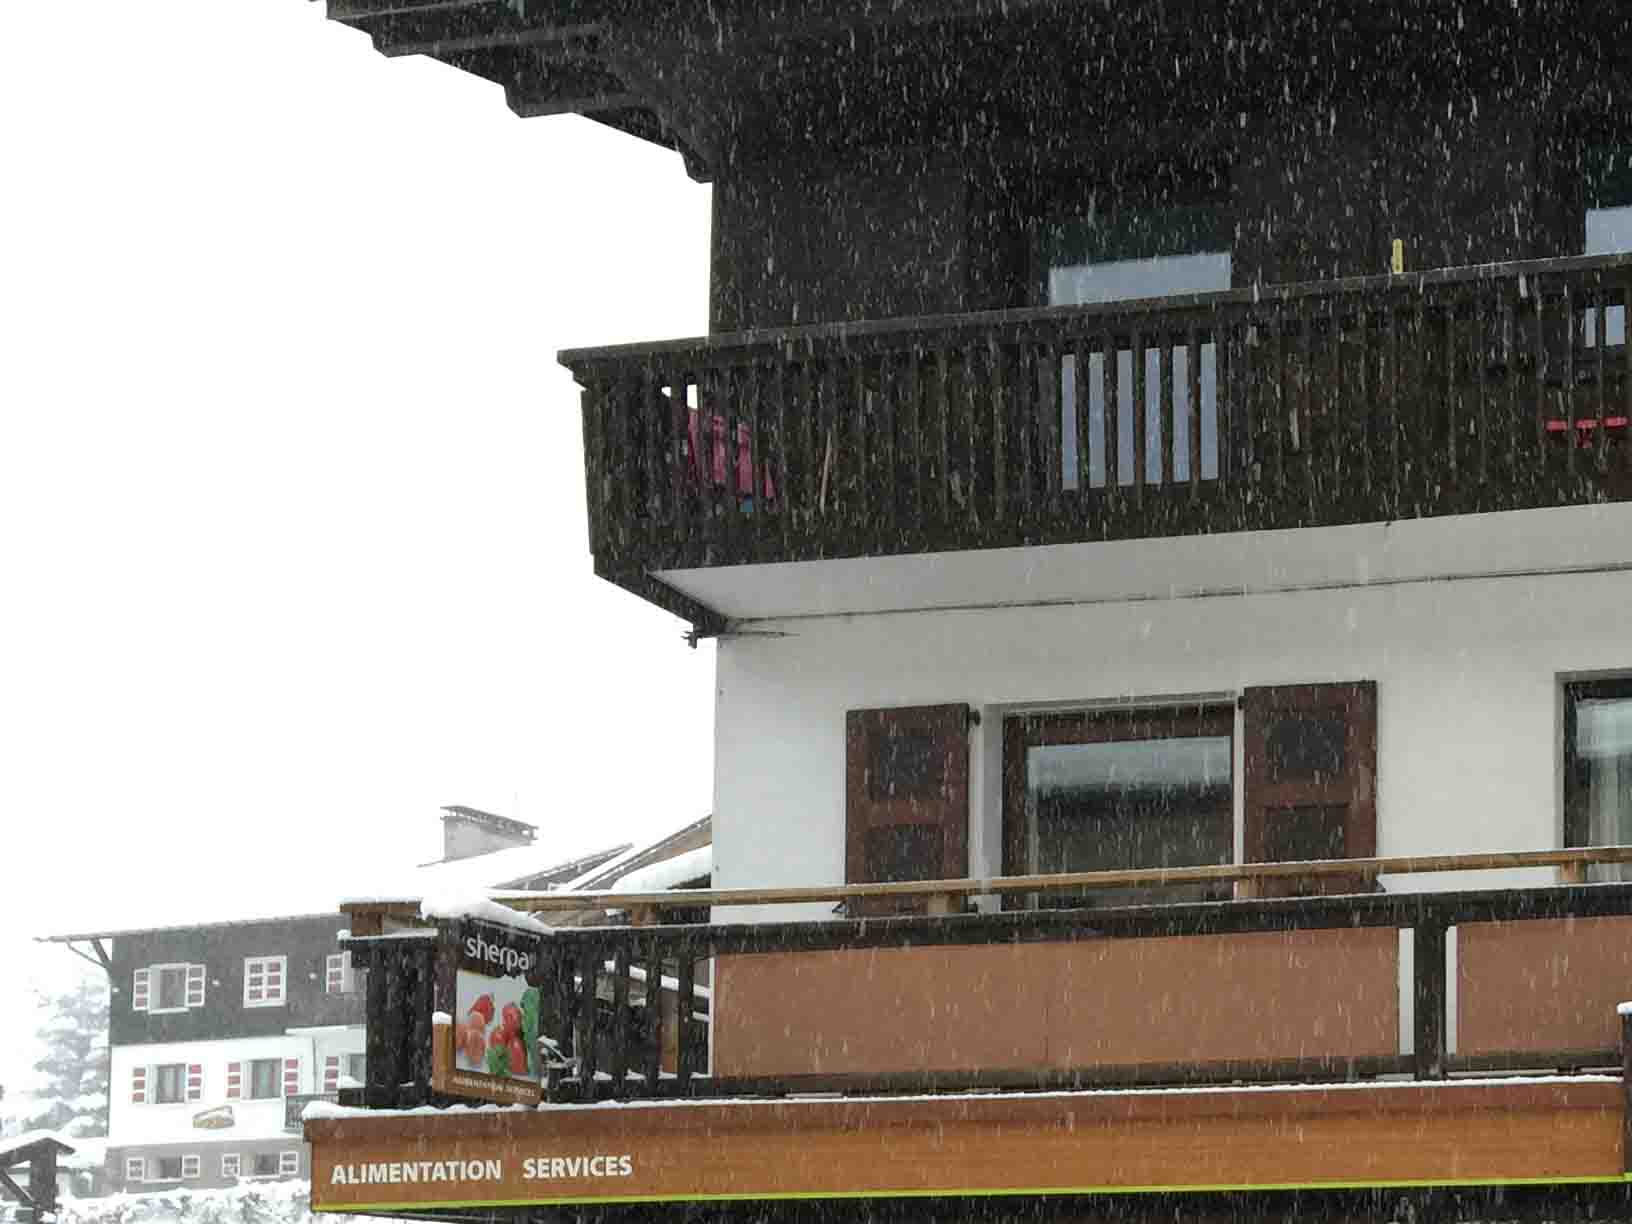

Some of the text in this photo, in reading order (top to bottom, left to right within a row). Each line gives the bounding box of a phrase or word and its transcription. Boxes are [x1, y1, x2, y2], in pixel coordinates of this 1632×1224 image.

[465, 937, 530, 971] sherpa
[331, 1155, 633, 1185] ALIMENTATION SERVICES
